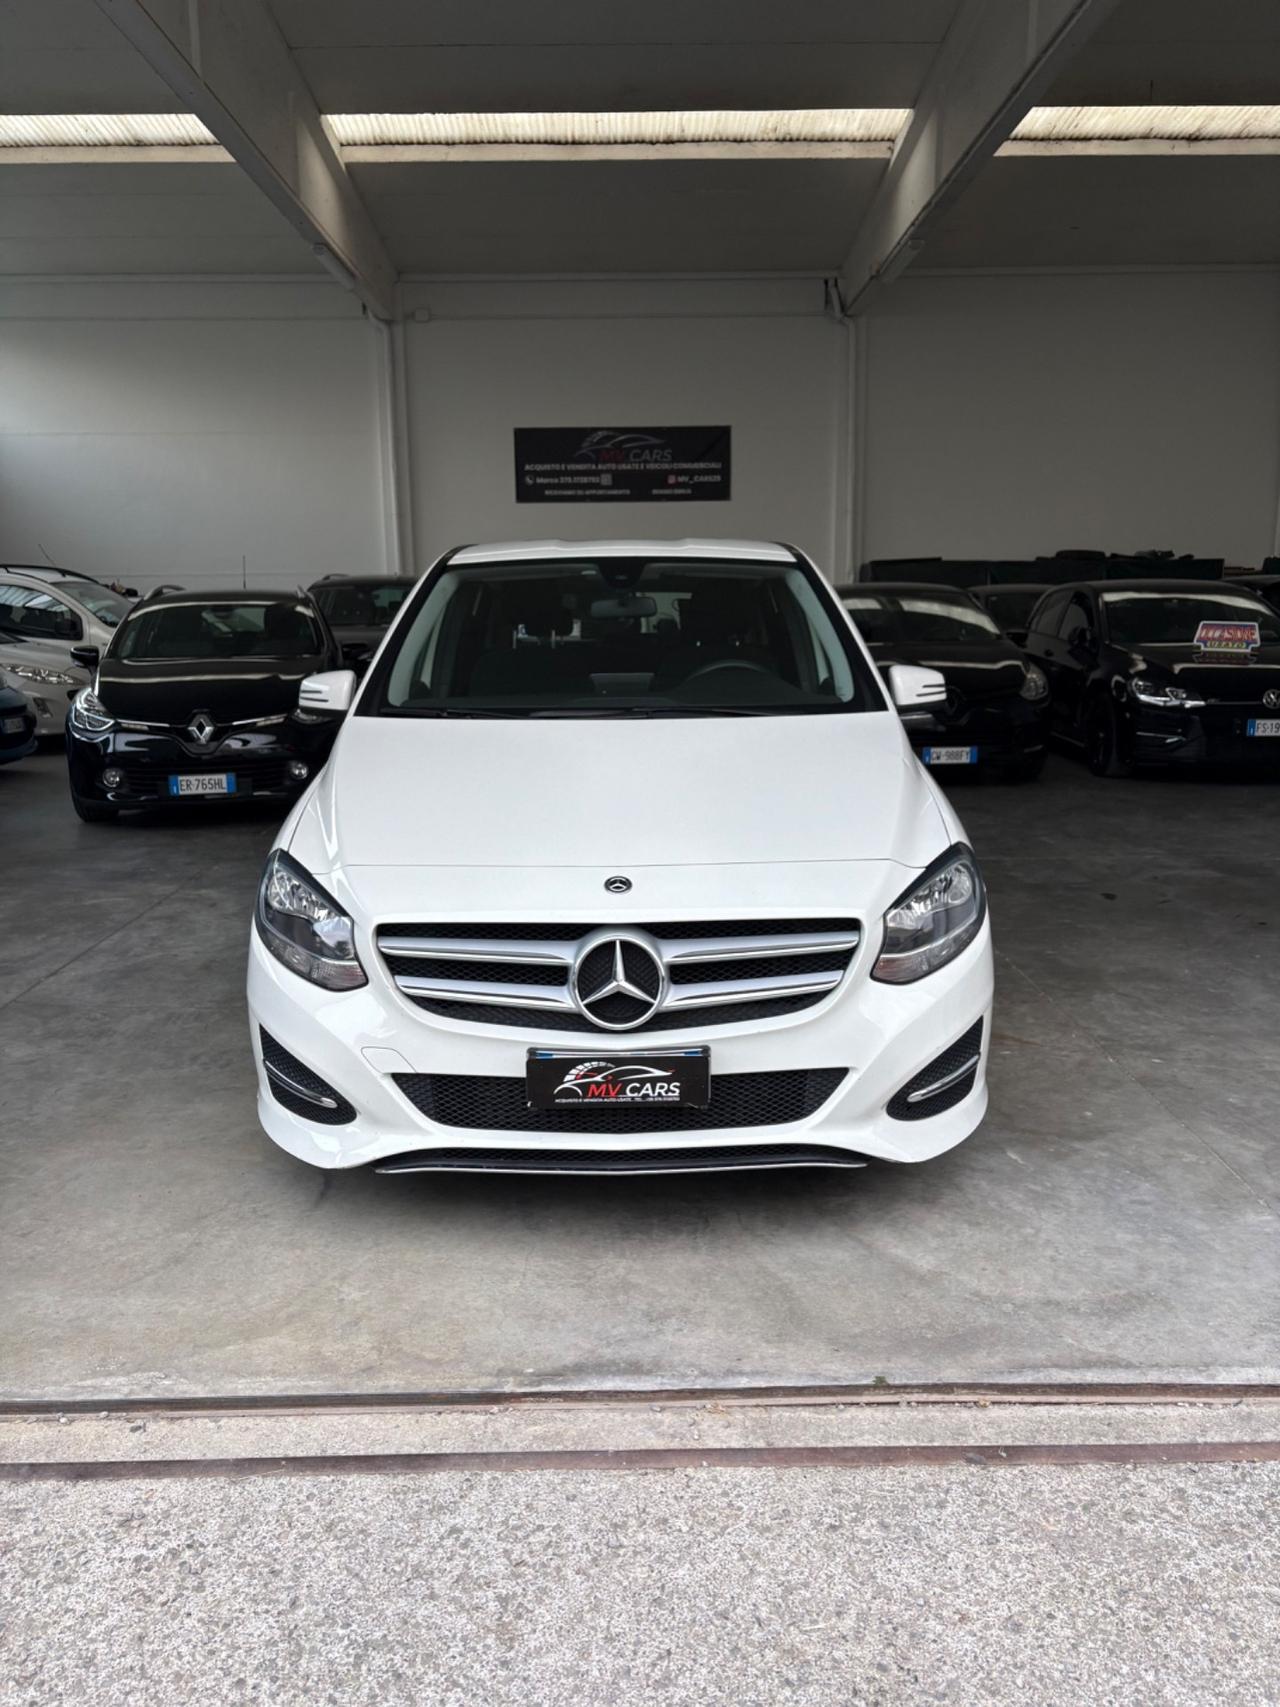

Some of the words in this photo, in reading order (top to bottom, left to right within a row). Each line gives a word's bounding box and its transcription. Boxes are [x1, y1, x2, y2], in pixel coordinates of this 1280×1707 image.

[599, 450, 623, 461] MV
[630, 449, 672, 462] CARS
[524, 463, 561, 471] ACQUISTO
[588, 1083, 623, 1098] MV
[626, 1082, 681, 1097] CARS
